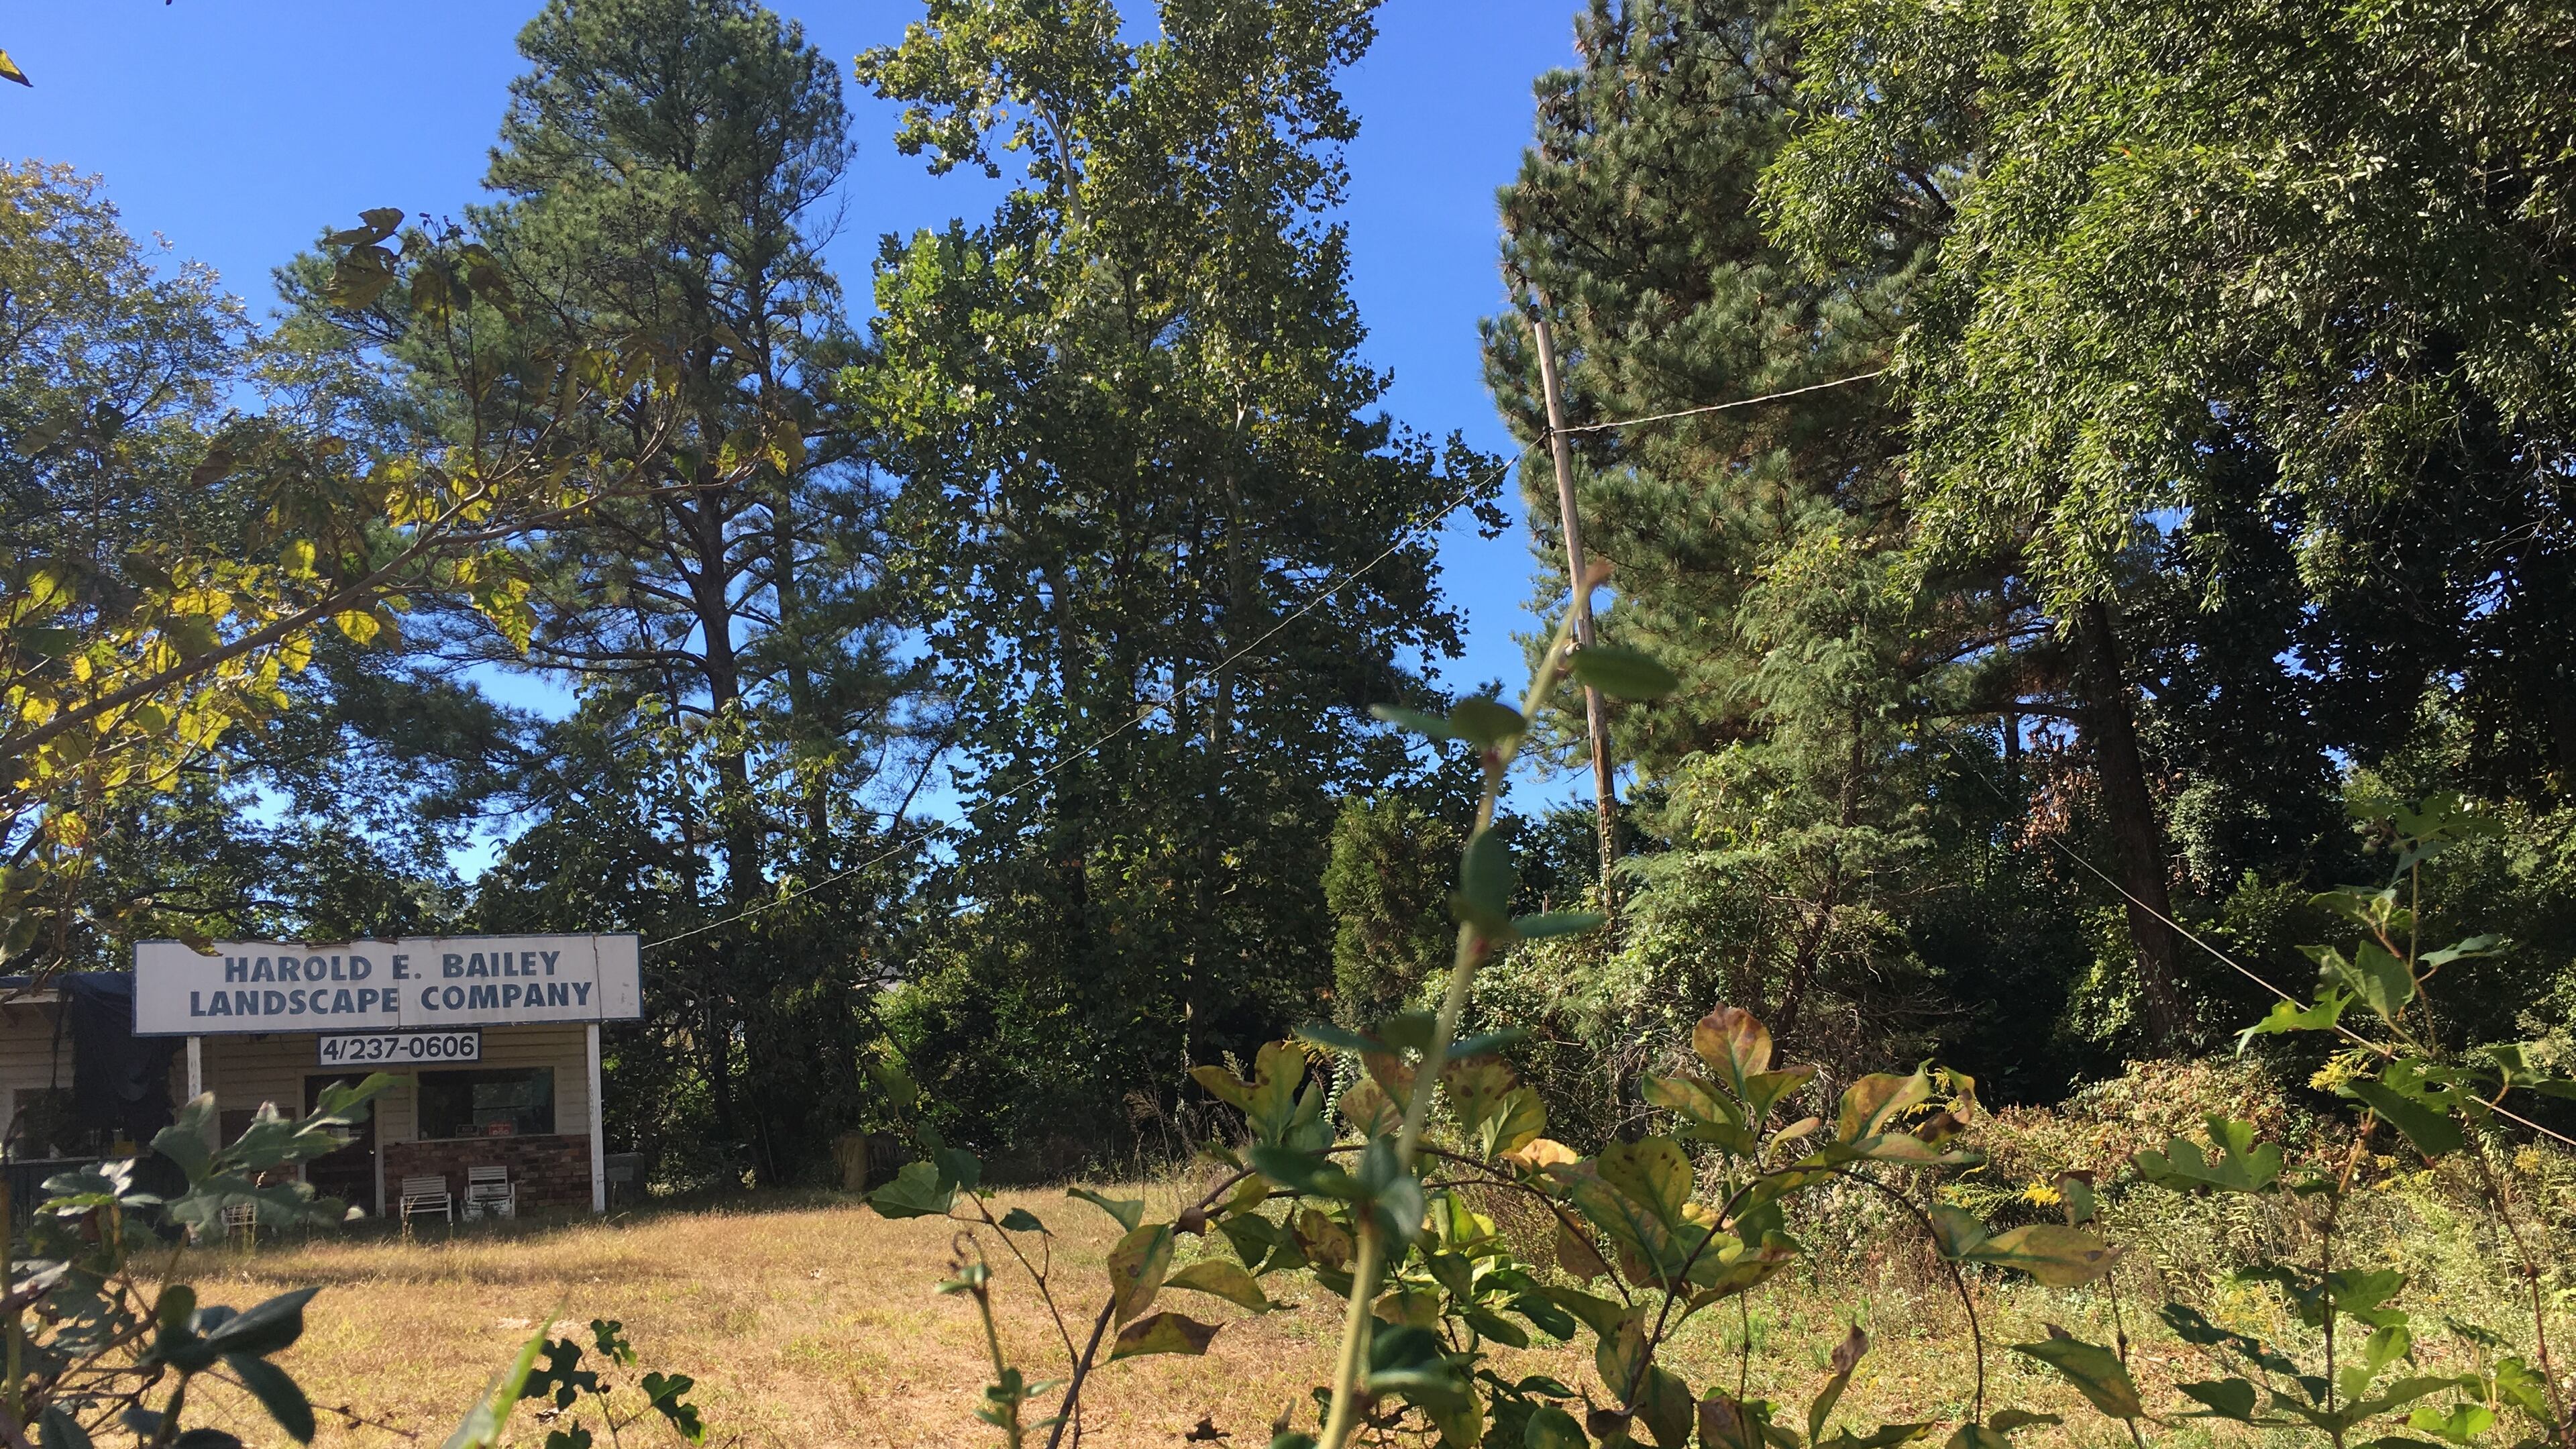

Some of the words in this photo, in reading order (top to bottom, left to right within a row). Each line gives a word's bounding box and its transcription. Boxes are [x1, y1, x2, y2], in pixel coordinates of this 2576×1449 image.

[225, 955, 372, 983] HAROLD
[392, 954, 422, 980] E.
[443, 951, 561, 979] BAILEY
[191, 987, 398, 1017] LANDSCAPE
[421, 981, 592, 1011] COMPANY
[323, 1034, 475, 1061] 4/237-0606
